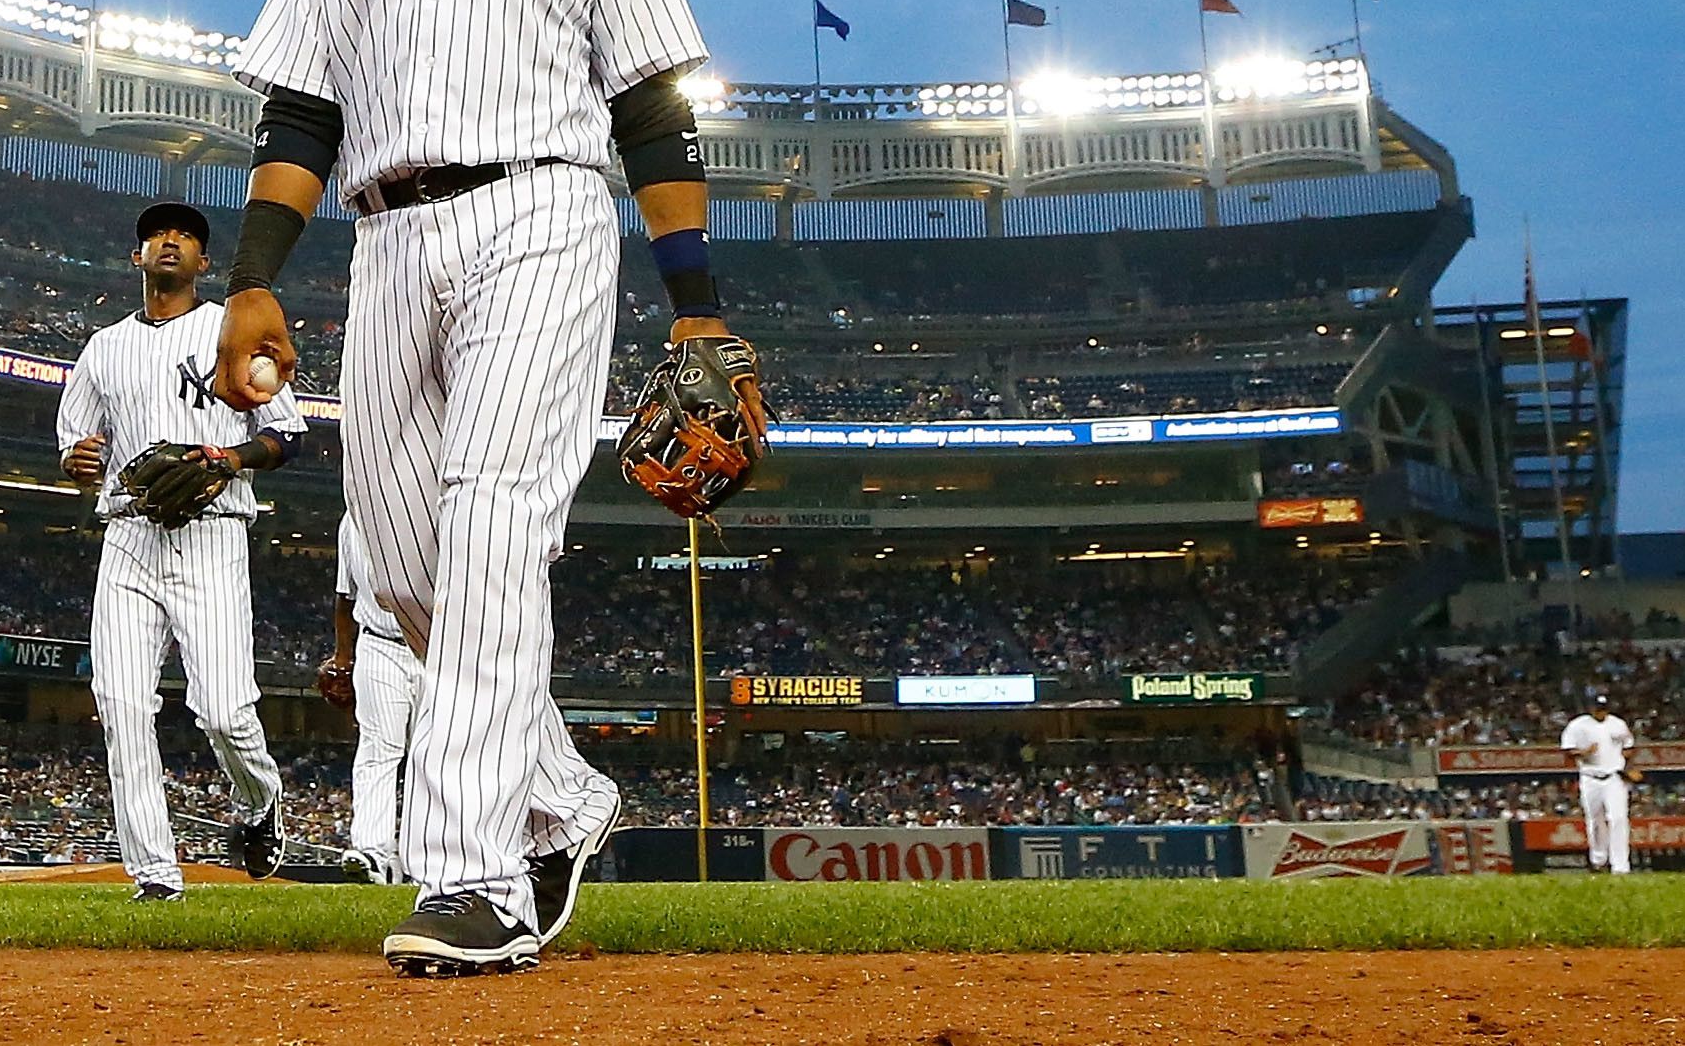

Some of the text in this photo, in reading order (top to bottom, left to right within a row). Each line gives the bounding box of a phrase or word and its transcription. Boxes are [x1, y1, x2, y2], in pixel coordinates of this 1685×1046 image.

[12, 359, 63, 383] SECTION
[16, 642, 62, 668] NYSE
[753, 678, 862, 696] SYRACUSE
[925, 681, 1007, 700] KUMON
[1132, 673, 1254, 701] Poland Spring
[769, 833, 988, 881] Canon
[1081, 866, 1217, 879] CONSULTING
